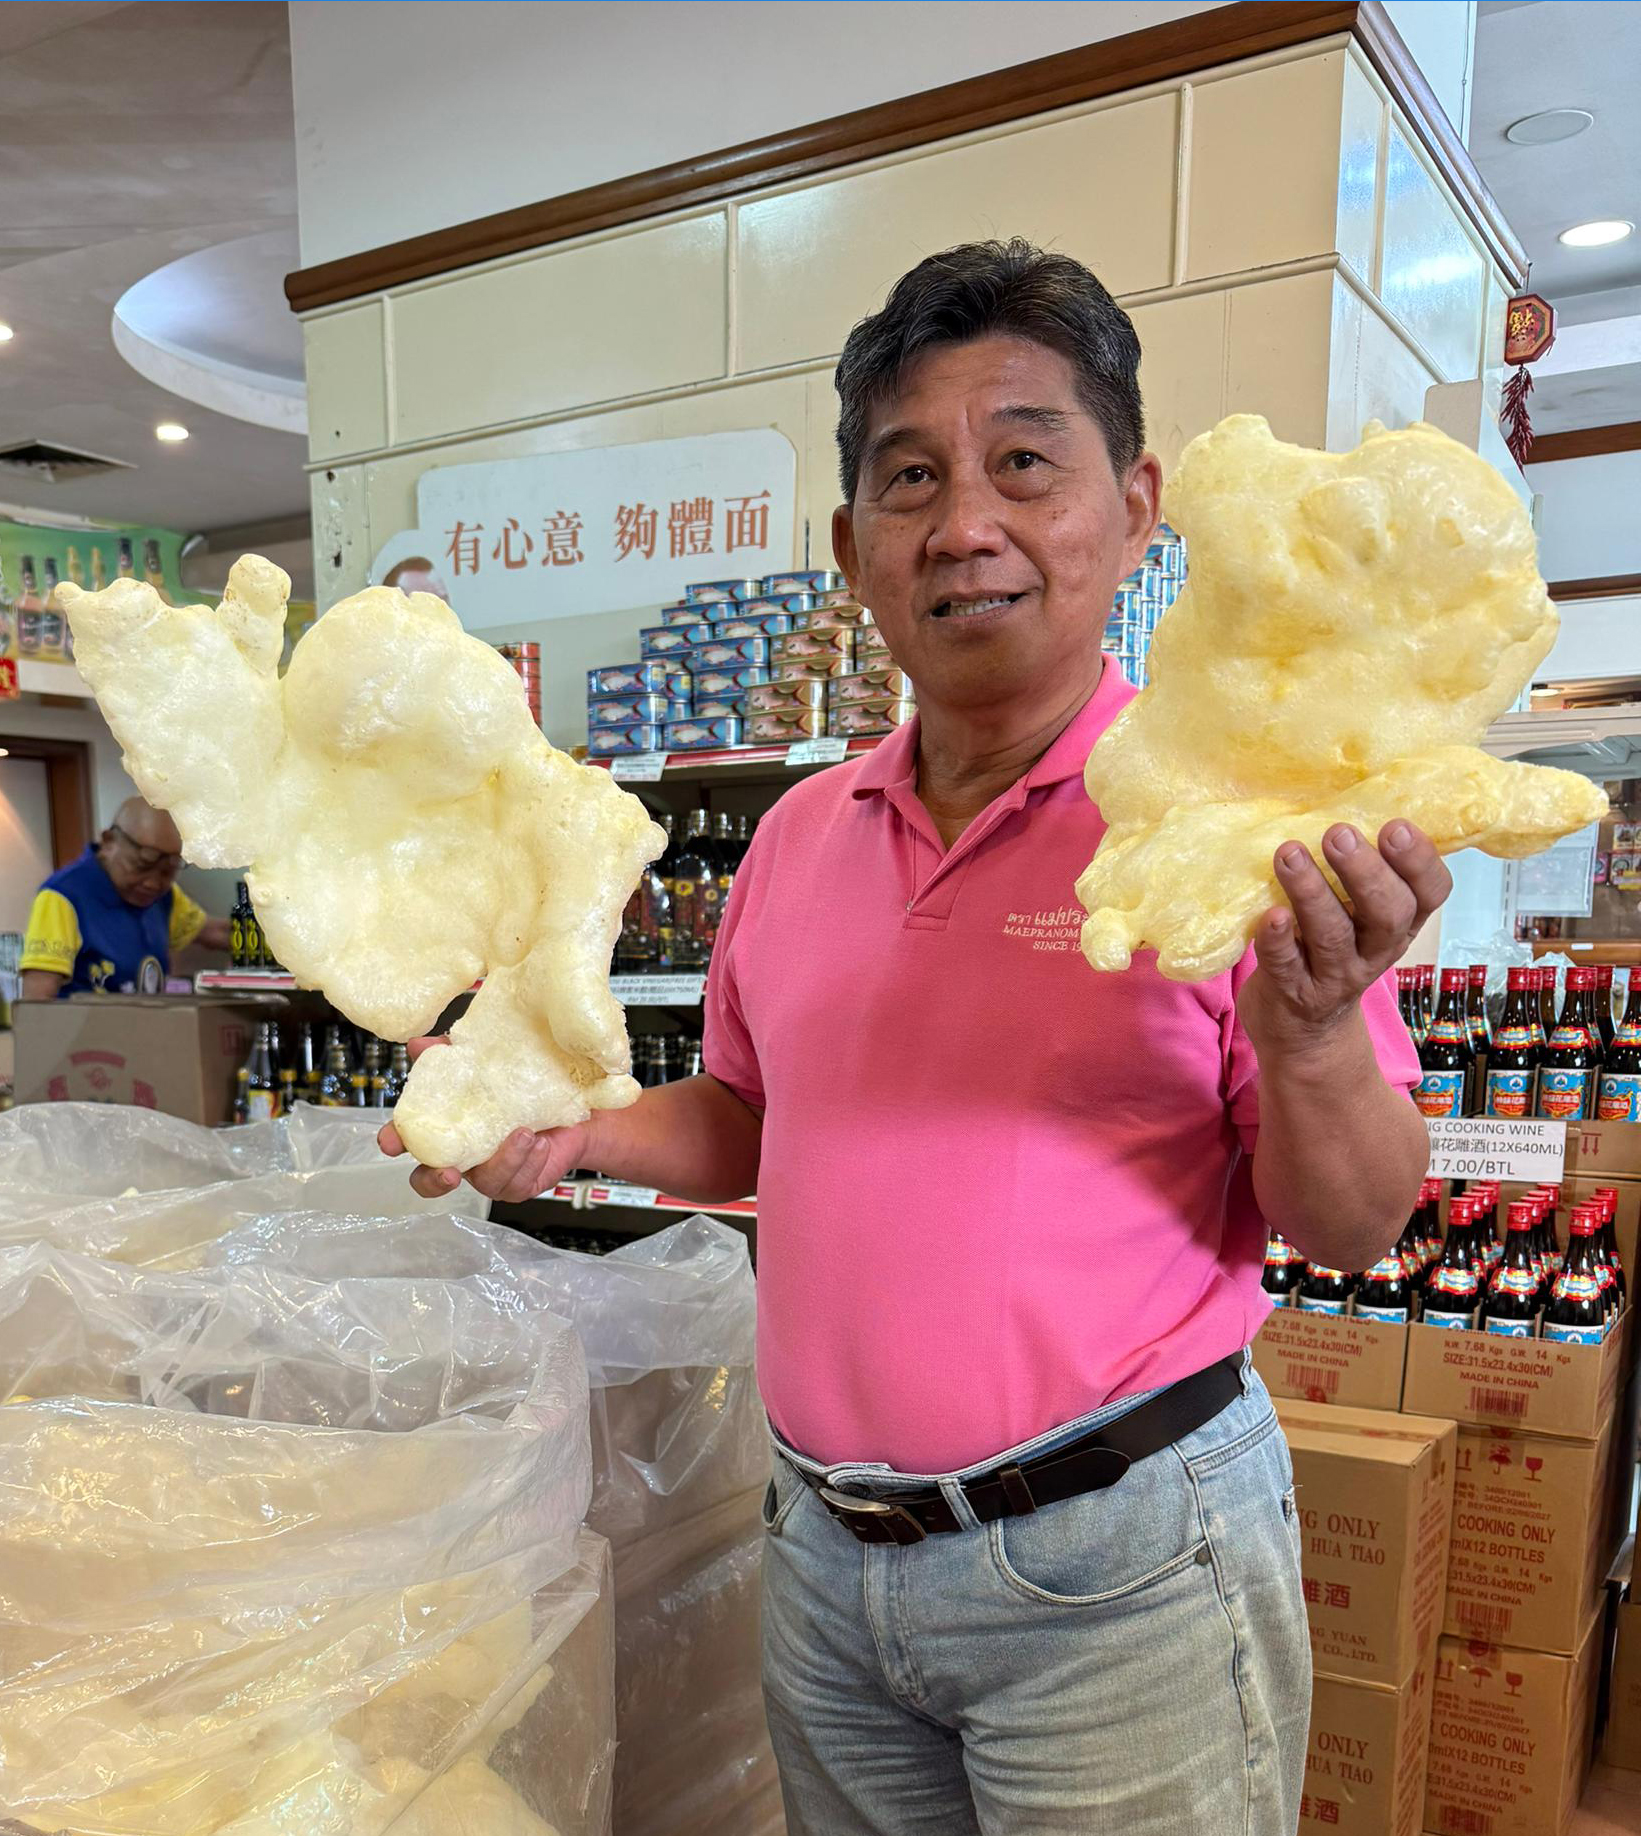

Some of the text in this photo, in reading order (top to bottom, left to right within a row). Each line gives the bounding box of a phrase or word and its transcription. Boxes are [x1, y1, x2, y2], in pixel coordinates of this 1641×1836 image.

[445, 489, 771, 577] 有心意 夠體面
[1003, 925, 1078, 938] MAEPRANOM
[1033, 941, 1068, 951] SINCE
[1445, 1122, 1505, 1135] COOKING
[1509, 1124, 1544, 1136] WINE
[1442, 1159, 1515, 1175] 7.00/BTL
[1347, 1330, 1357, 1340] 14
[1277, 1349, 1349, 1367] MADE IN CHINA
[1464, 1340, 1485, 1352] 7.68
[1489, 1345, 1503, 1356] Kgs
[1536, 1350, 1547, 1360] 14
[1443, 1352, 1554, 1378] SIZE:31.5x23.4x30(CM)
[1460, 1371, 1539, 1389] MADE IN CHINA
[1327, 1513, 1380, 1540] ONLY
[1457, 1514, 1556, 1544] COOKING ONLY
[1311, 1537, 1385, 1566] HUA TIAO
[1489, 1543, 1545, 1563] BOTTLES
[1519, 1568, 1530, 1578] 14
[1477, 1591, 1488, 1600] IN
[1490, 1593, 1521, 1605] CHINA
[1332, 1630, 1367, 1646] YUAN
[1318, 1731, 1369, 1759] ONLY
[1440, 1722, 1497, 1748] COOKING
[1502, 1736, 1536, 1757] ONLY
[1471, 1751, 1526, 1775] BOTTLES
[1339, 1761, 1373, 1785] TIAO
[1472, 1799, 1503, 1814] CHINA
